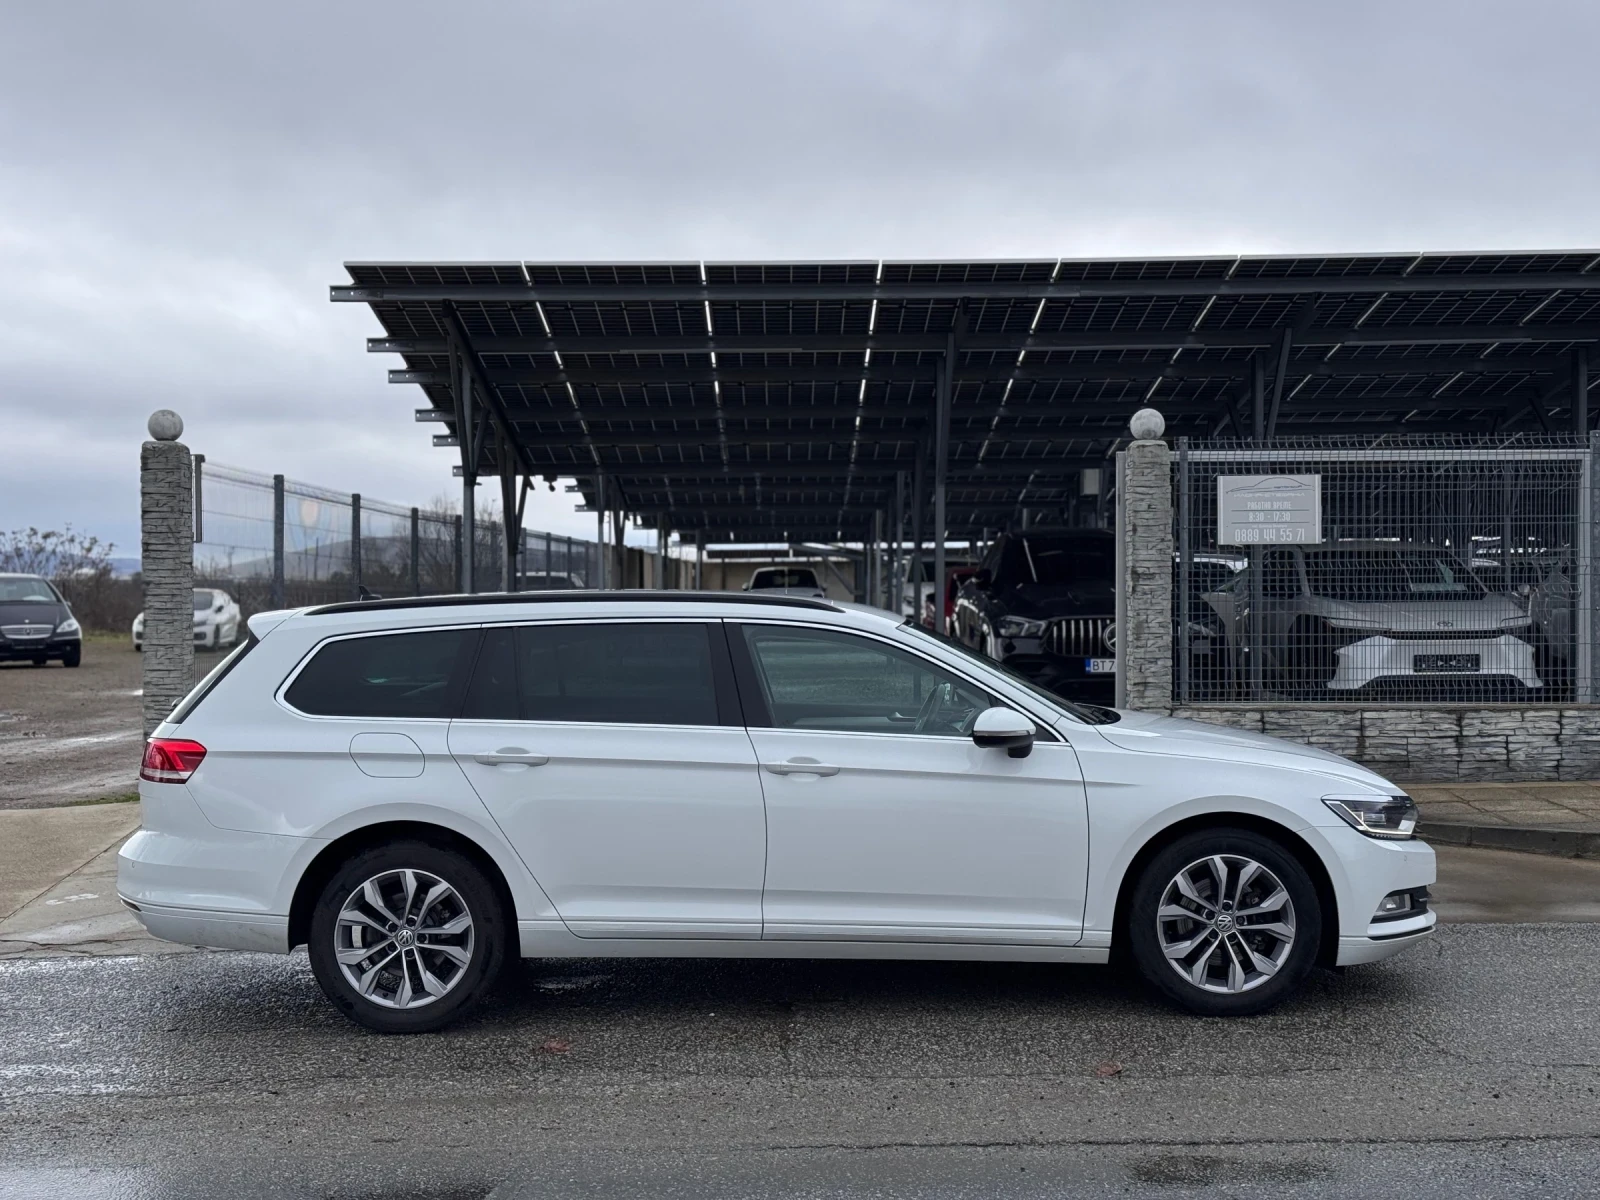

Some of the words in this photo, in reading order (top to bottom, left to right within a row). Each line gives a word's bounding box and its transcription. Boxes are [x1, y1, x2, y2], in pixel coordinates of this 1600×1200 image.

[1248, 511, 1264, 522] 8:30
[1273, 511, 1291, 522] 17:30
[1234, 528, 1259, 542] 0889
[1263, 528, 1276, 542] 44
[1280, 528, 1293, 542] 55
[1296, 528, 1305, 541] 71
